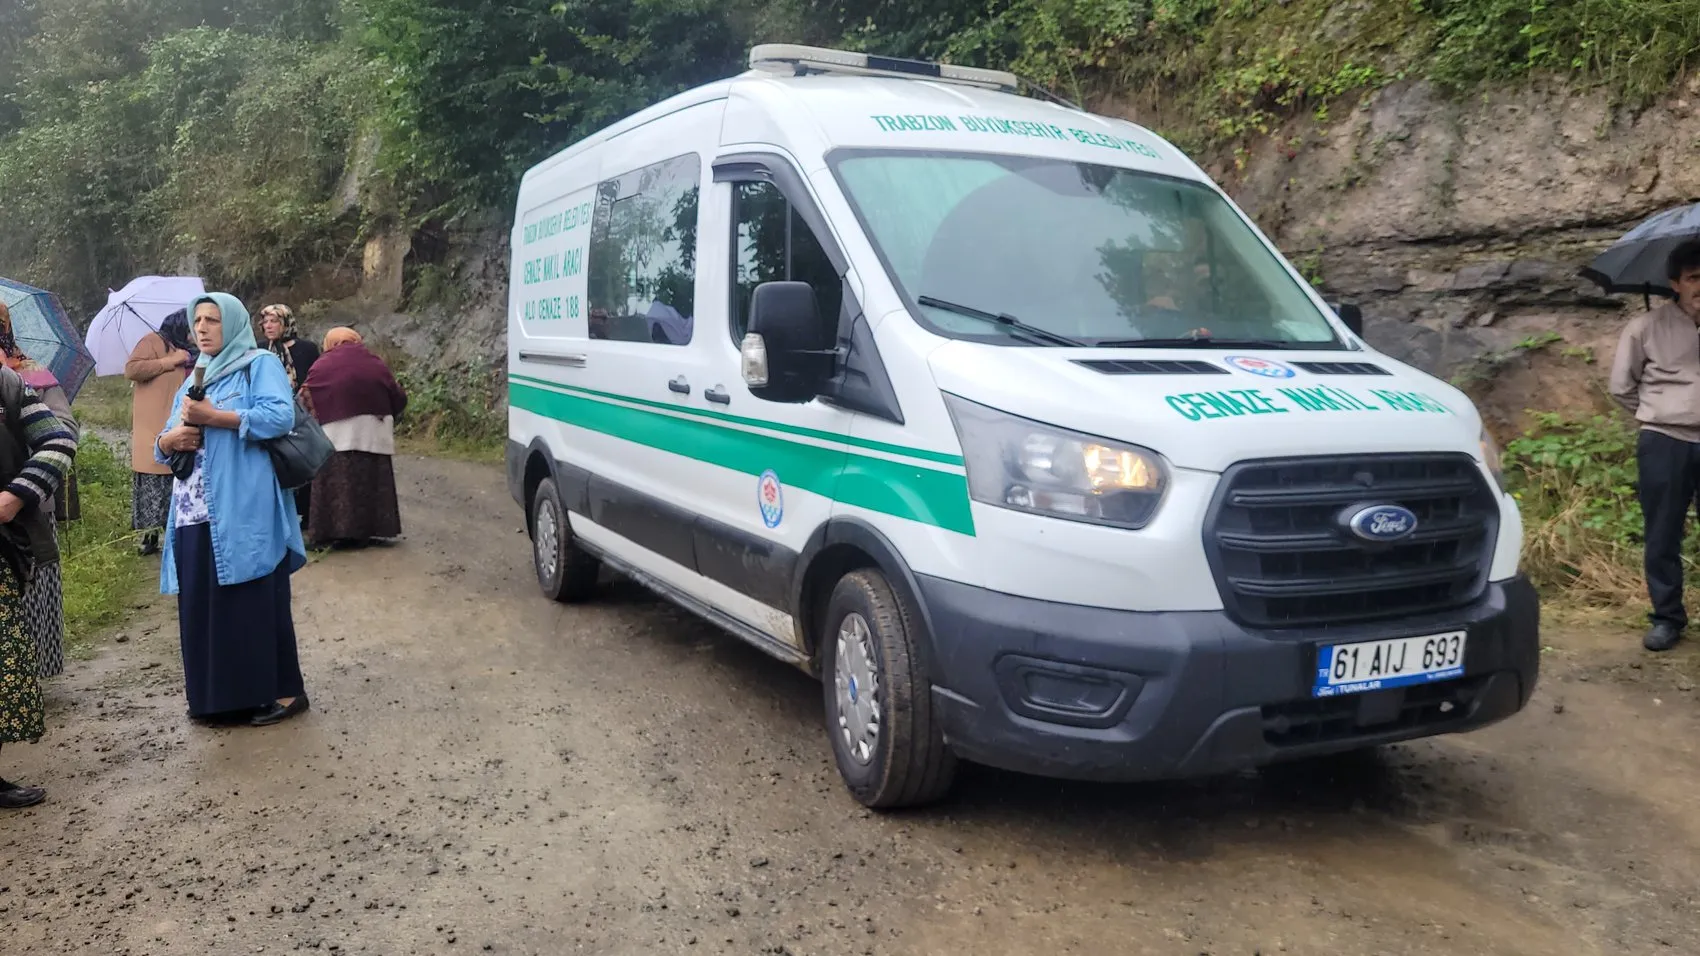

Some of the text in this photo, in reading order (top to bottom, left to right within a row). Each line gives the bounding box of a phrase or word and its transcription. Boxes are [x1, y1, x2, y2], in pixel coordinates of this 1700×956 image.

[870, 115, 958, 132] TRABZON
[523, 257, 542, 285] CENAZE
[525, 295, 579, 320] ALO CENAZE 188
[1165, 389, 1290, 421] CENAZE
[1277, 384, 1380, 411] NAKİL
[1370, 511, 1407, 533] Ford
[1334, 635, 1460, 679] 61 AIJ 693
[1318, 669, 1329, 678] TR
[1339, 681, 1381, 694] TUNALAR
